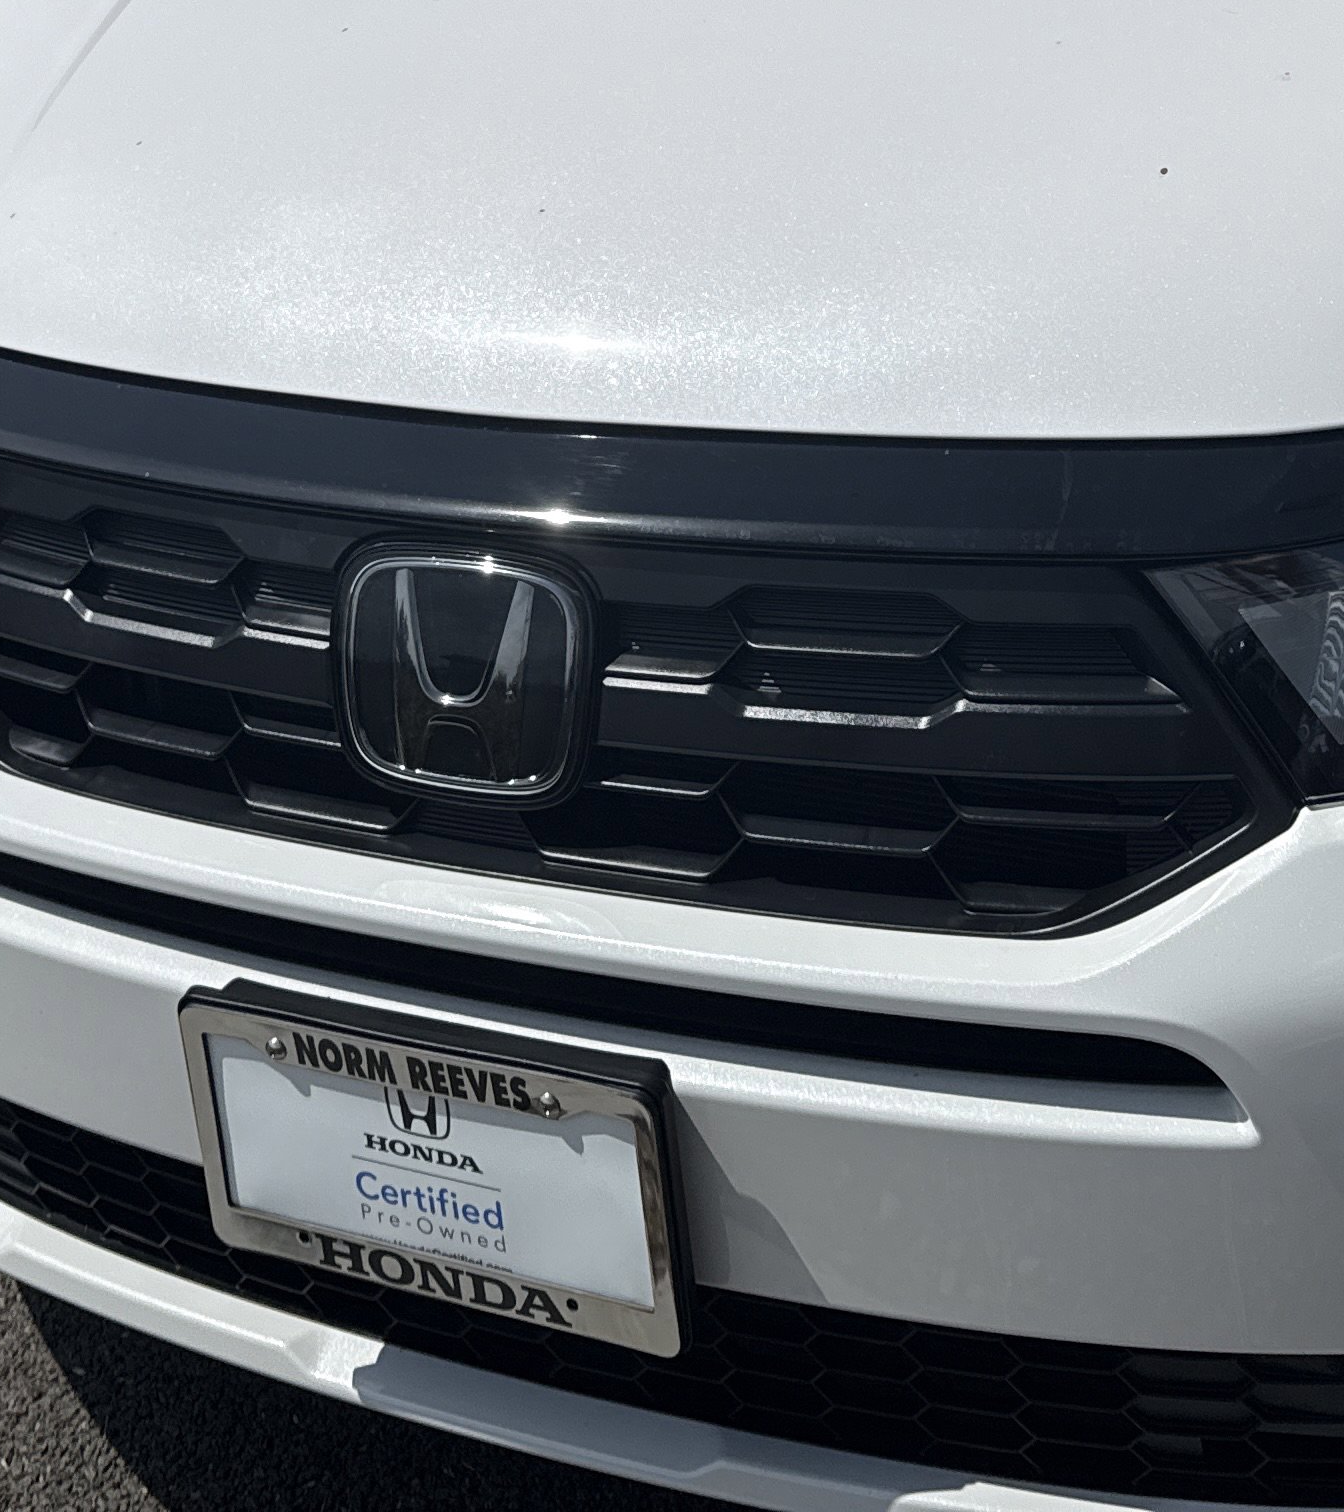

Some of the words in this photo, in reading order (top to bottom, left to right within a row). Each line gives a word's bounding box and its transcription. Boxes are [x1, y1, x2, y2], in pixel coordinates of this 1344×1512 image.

[292, 1031, 398, 1086] NORM
[405, 1056, 532, 1112] REEVES
[363, 1132, 484, 1175] HONDA
[355, 1170, 505, 1231] Certified
[360, 1202, 508, 1254] Pre-Owned
[315, 1233, 573, 1328] HONDA
